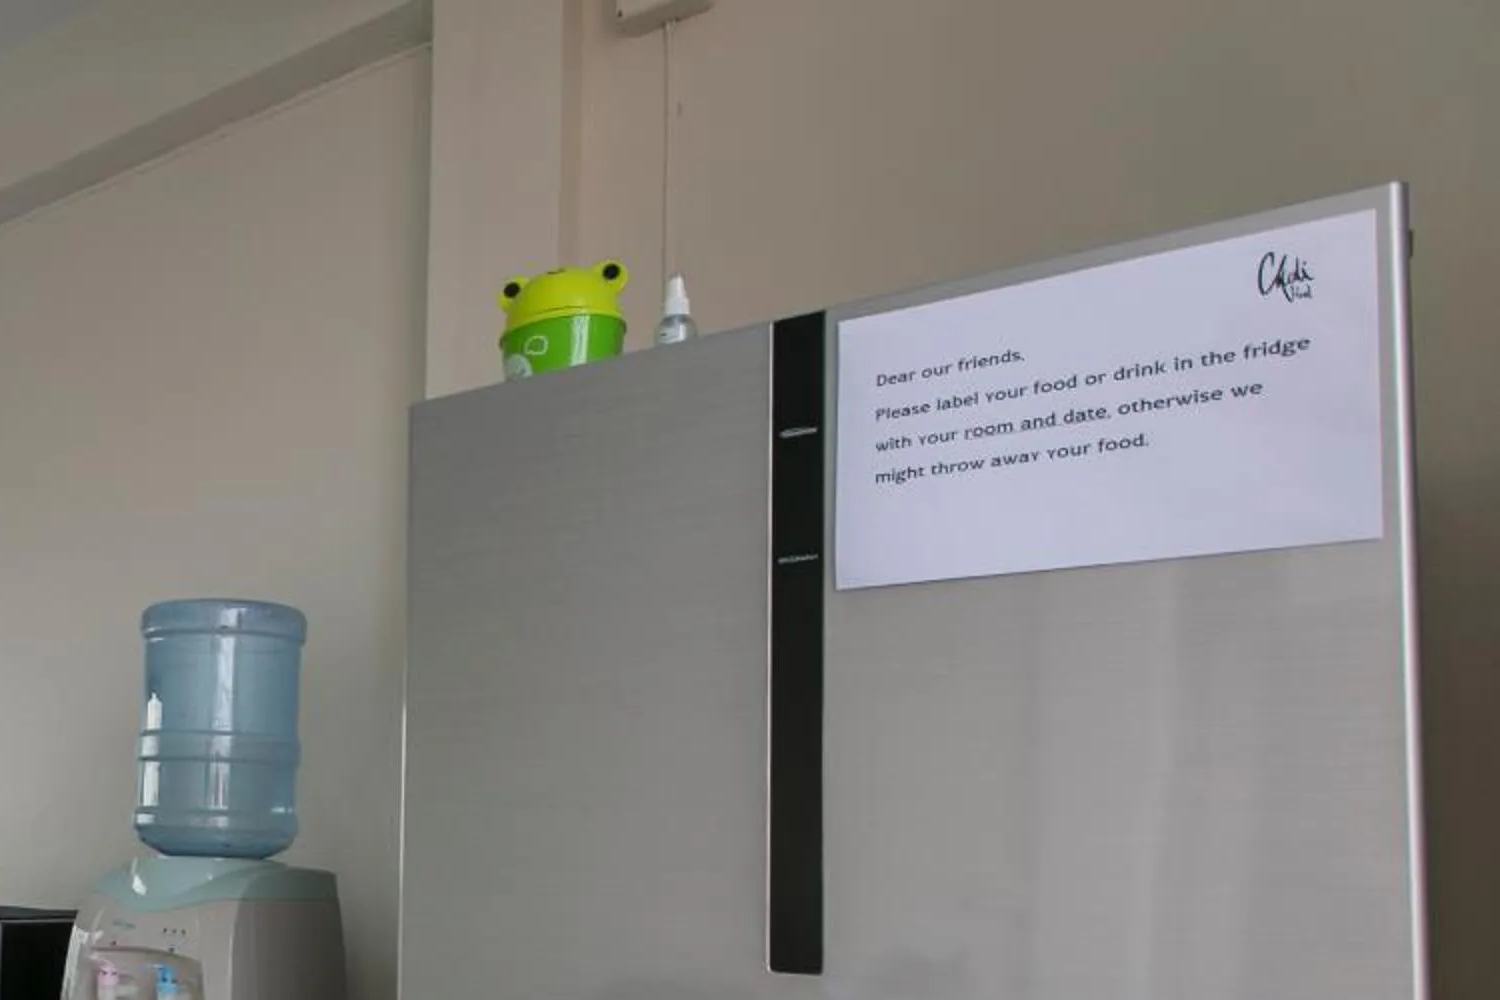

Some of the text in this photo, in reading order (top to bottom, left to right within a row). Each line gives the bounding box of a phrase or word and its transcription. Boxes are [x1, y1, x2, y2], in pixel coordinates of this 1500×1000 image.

[875, 337, 1311, 421] Please label your food or drink in the fridge
[876, 371, 916, 387] Dear
[921, 363, 953, 379] our
[875, 435, 912, 452] with
[918, 430, 958, 447] your
[964, 420, 1014, 440] room
[1020, 412, 1057, 430] and
[1117, 389, 1223, 415] otherwise
[1230, 383, 1263, 398] we
[875, 465, 925, 484] might
[931, 458, 985, 476] throw
[990, 450, 1041, 467] away
[1046, 443, 1092, 460] your
